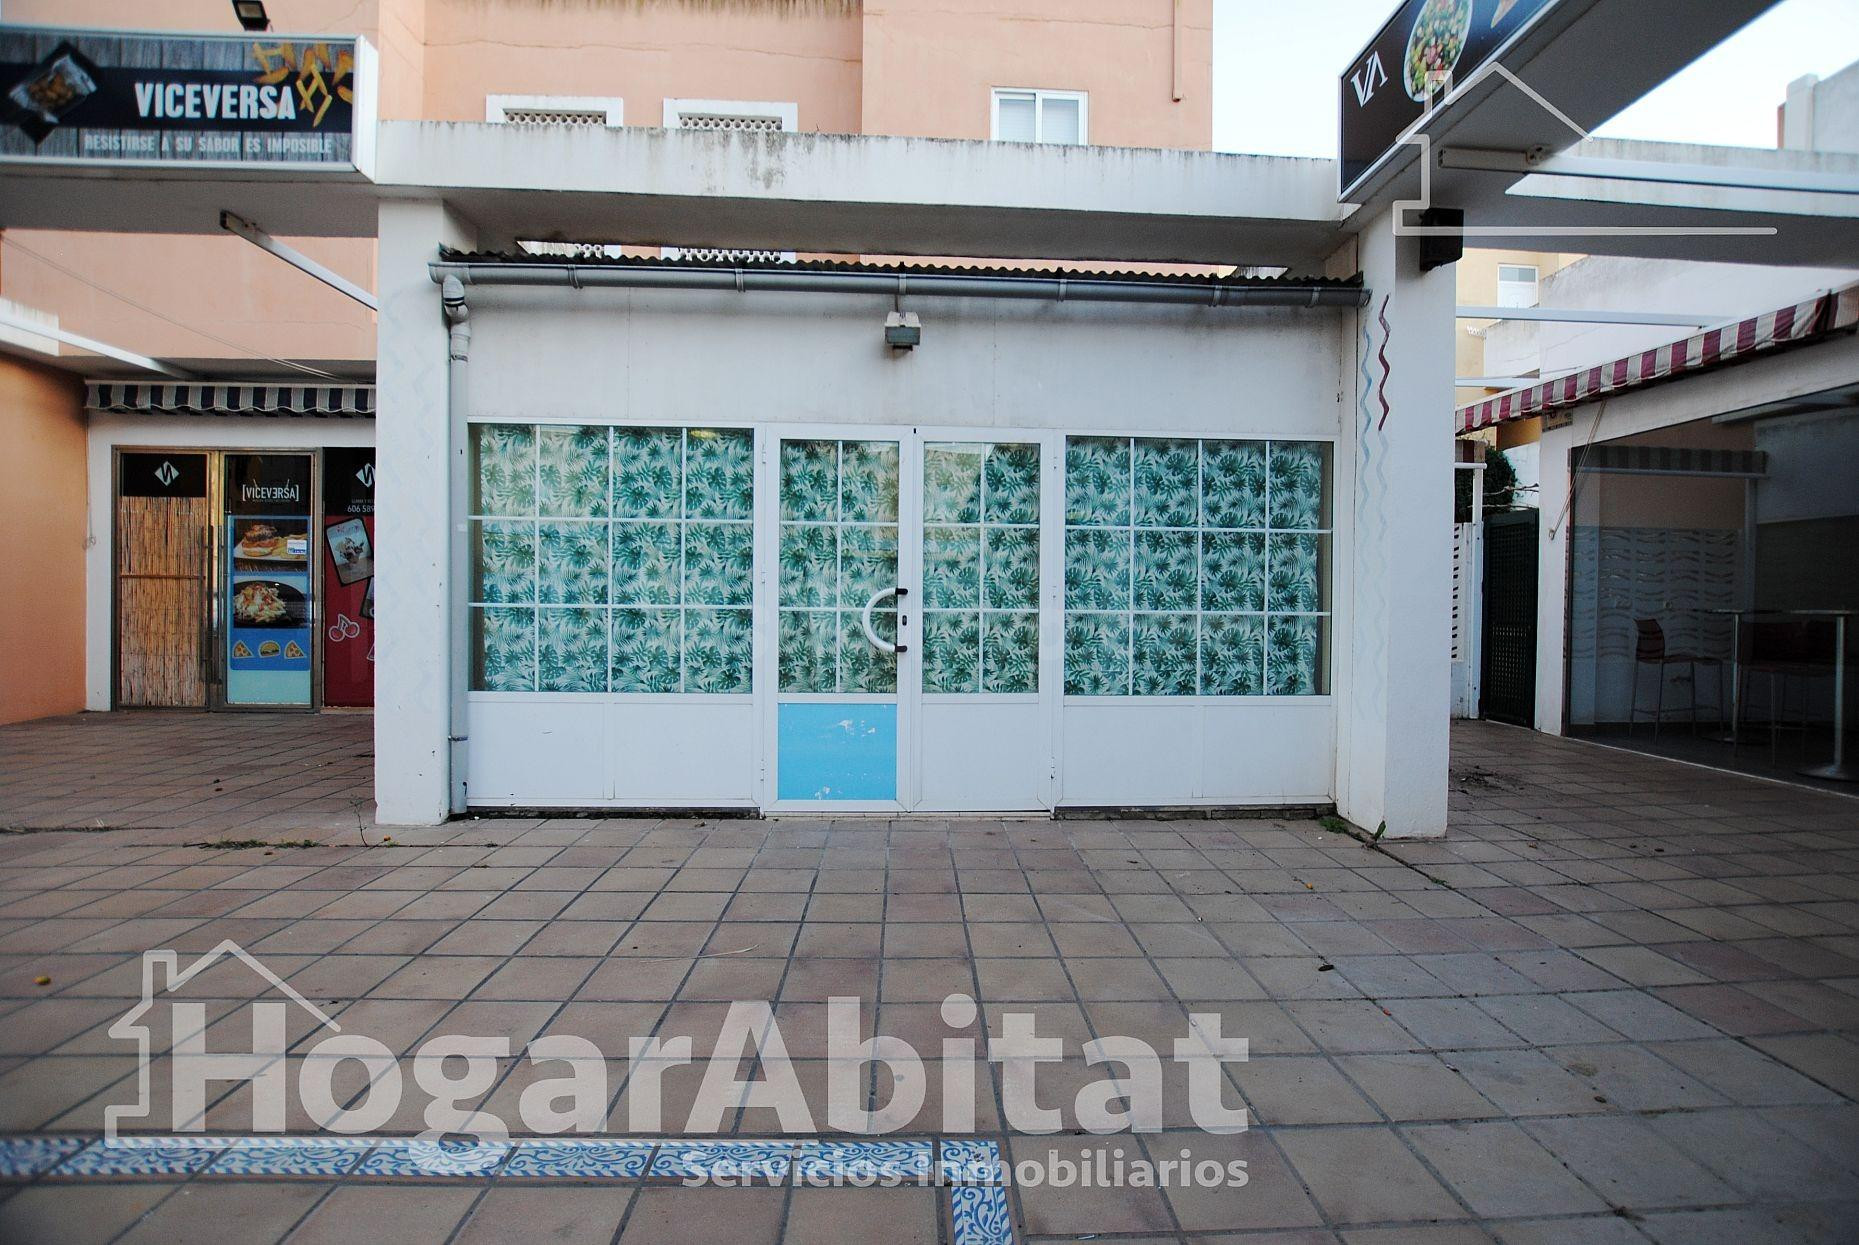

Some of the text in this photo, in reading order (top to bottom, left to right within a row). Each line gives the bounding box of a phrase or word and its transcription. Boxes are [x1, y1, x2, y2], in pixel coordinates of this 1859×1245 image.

[134, 81, 296, 120] VICEVERSA
[84, 134, 332, 154] RESISTIRSE A SU SABOR ES IMPOSIBLE
[347, 504, 360, 513] 606
